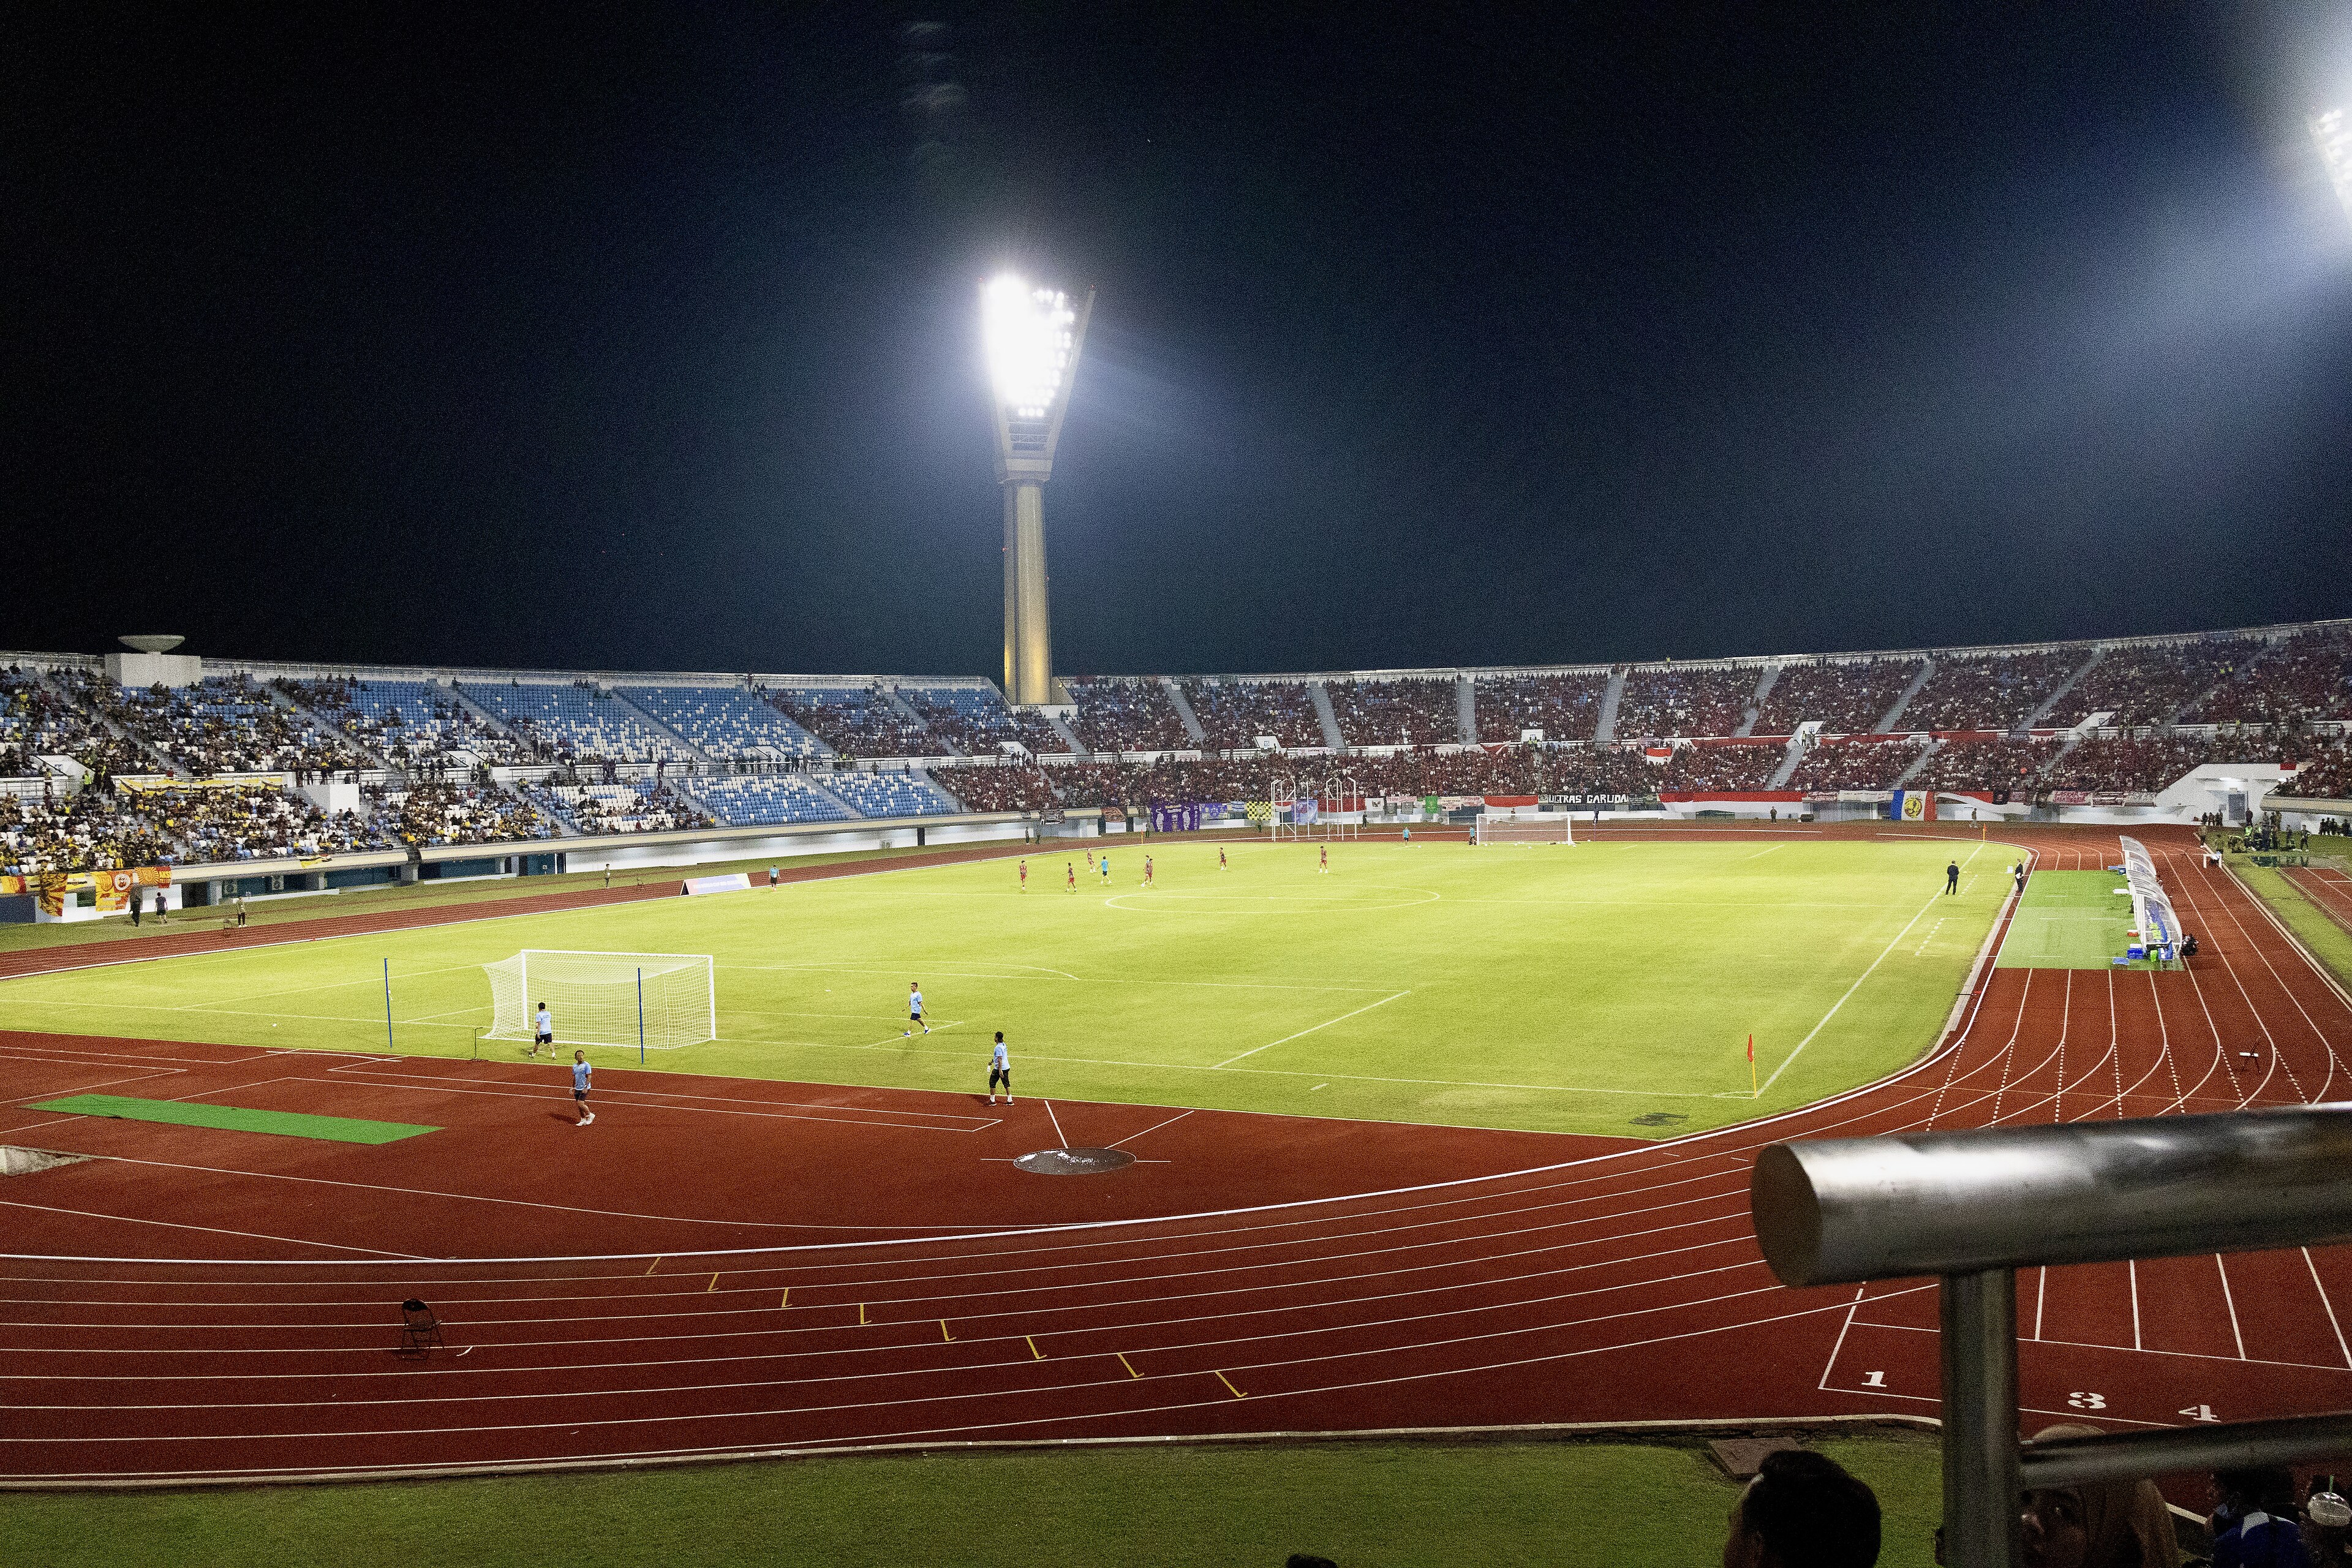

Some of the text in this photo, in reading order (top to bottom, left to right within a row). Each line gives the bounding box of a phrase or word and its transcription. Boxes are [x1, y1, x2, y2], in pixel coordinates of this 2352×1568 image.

[1548, 794, 1581, 804] ULTRAS
[1586, 794, 1629, 804] GARUDA
[1861, 1371, 1887, 1387] 1
[2068, 1392, 2106, 1409] 3
[2178, 1404, 2222, 1422] 4
